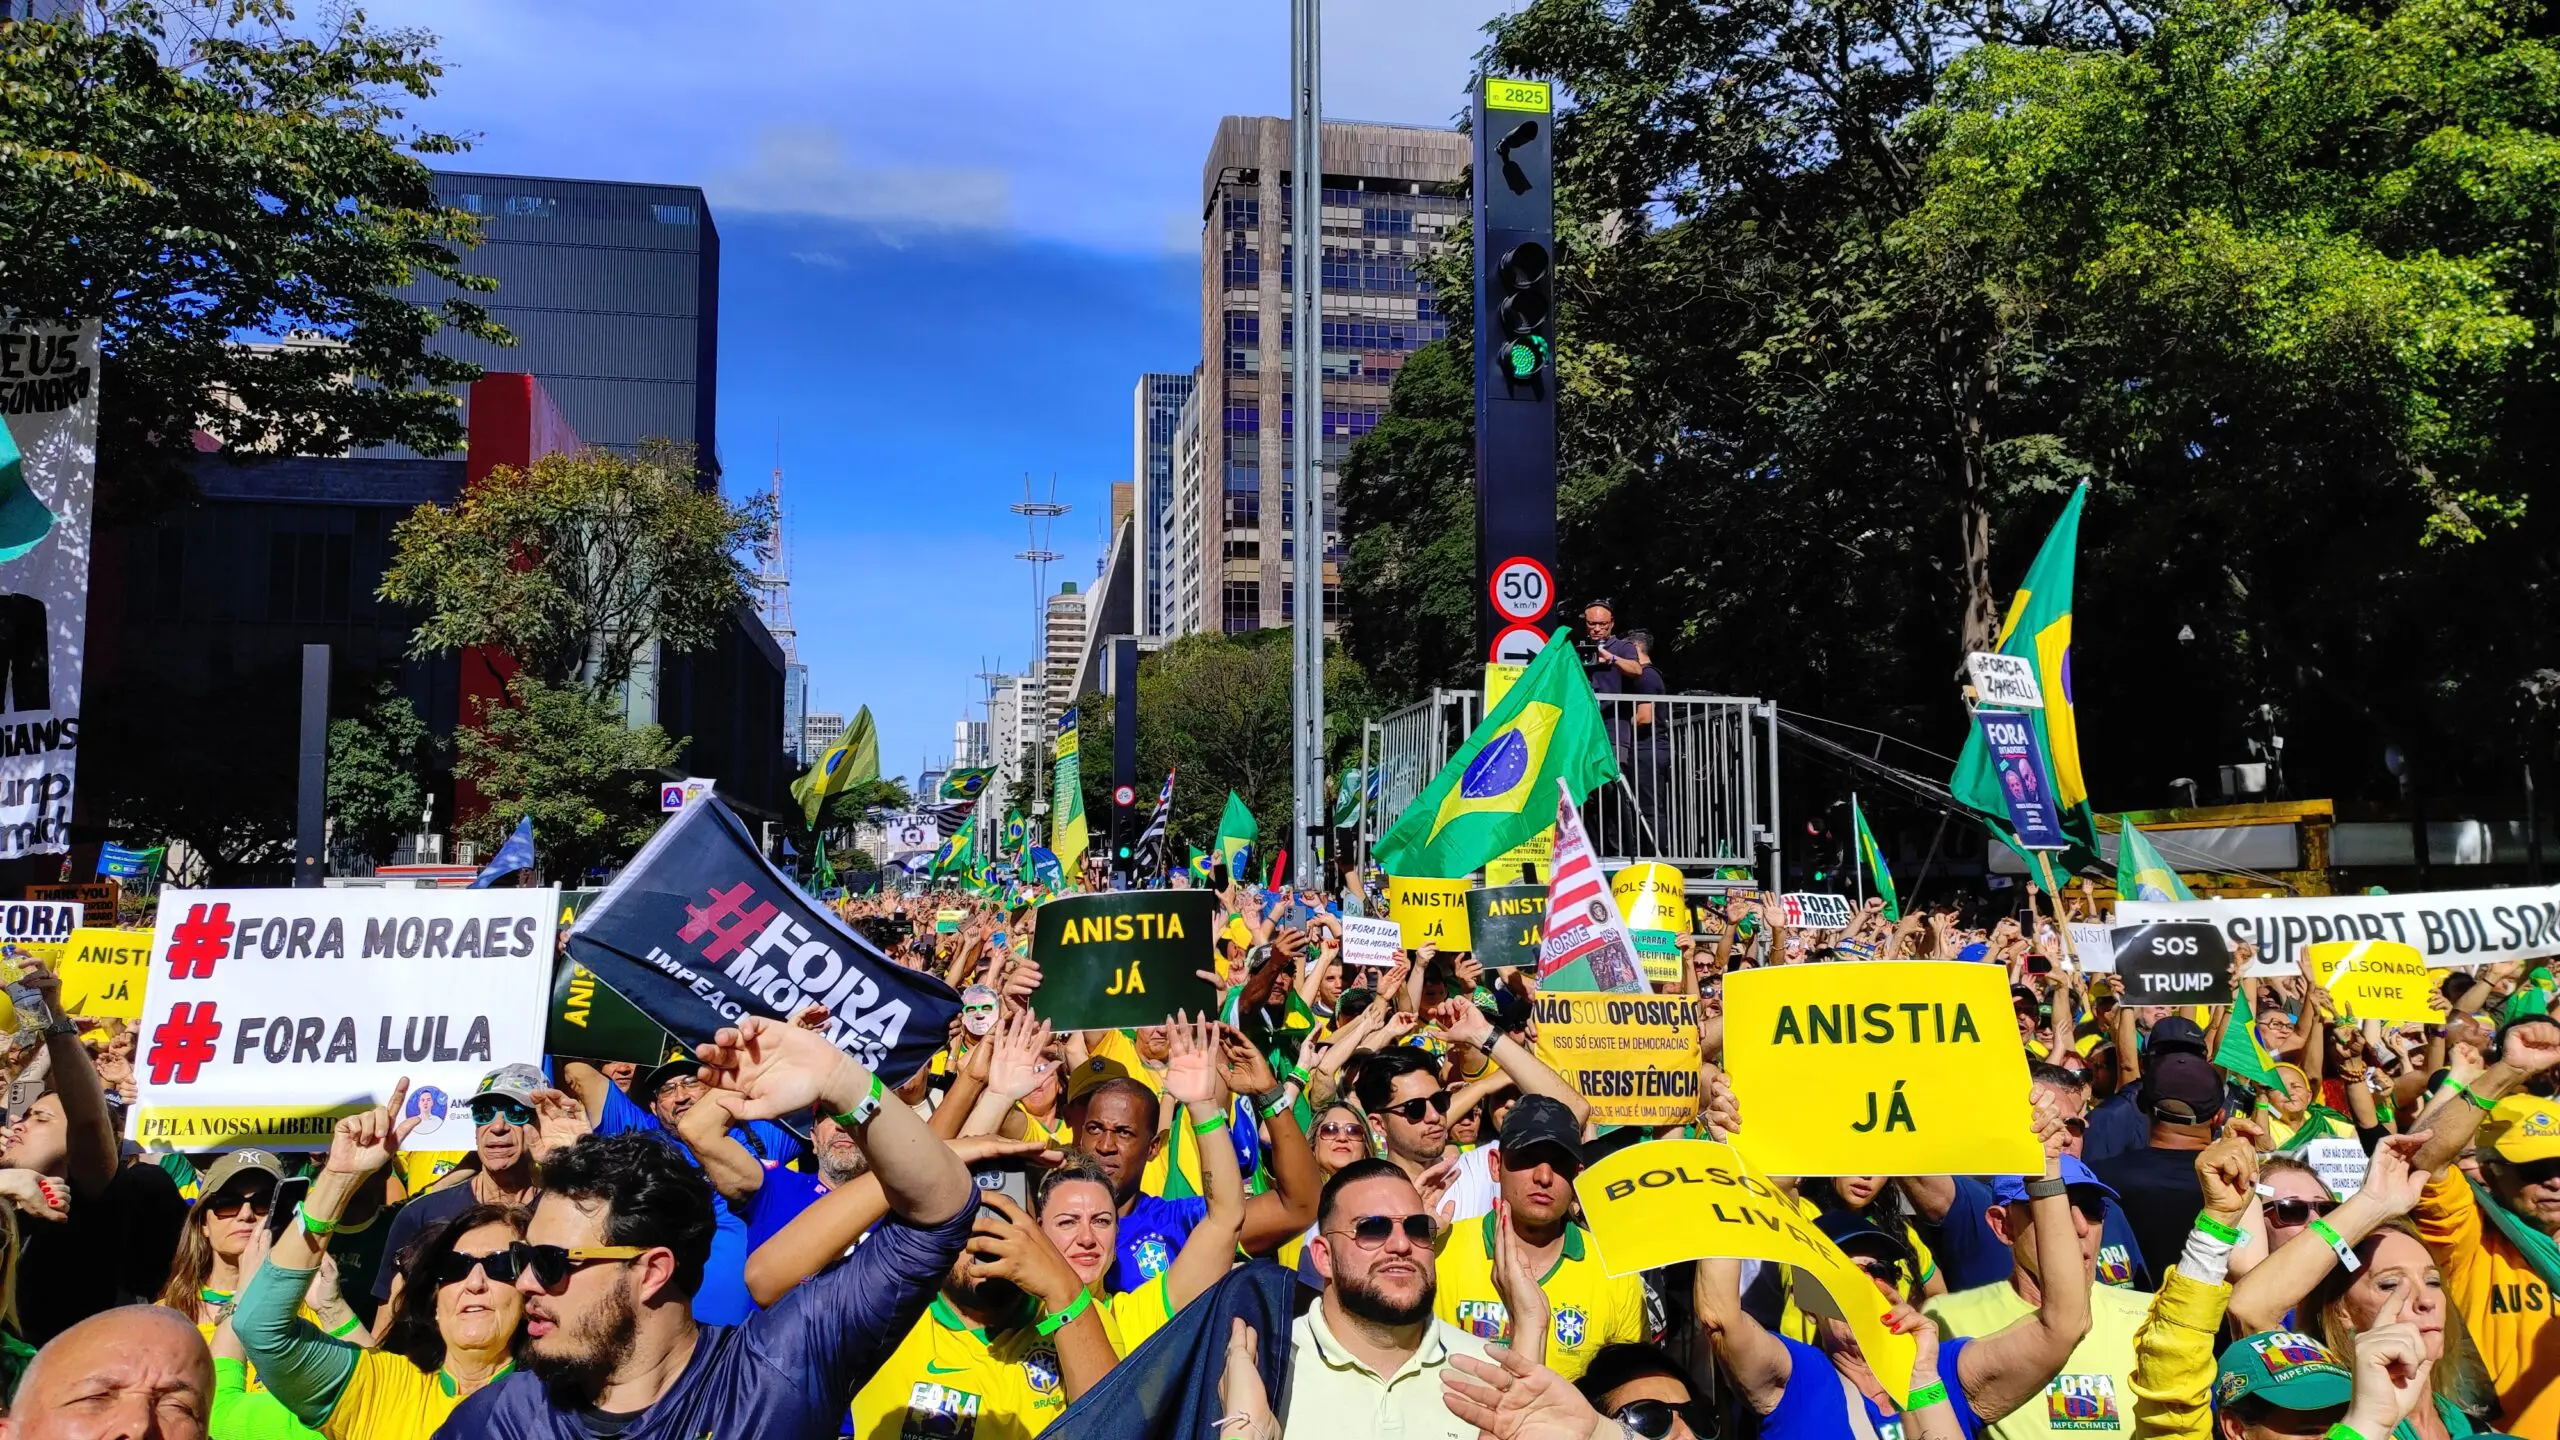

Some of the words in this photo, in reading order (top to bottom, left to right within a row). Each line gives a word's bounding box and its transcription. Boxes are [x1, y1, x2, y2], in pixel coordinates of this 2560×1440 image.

[1505, 88, 1543, 105] 2825
[1503, 572, 1542, 600] 50
[1513, 601, 1538, 609] km/h
[1986, 723, 2029, 746] FORA
[909, 815, 936, 827] LIXO
[1401, 891, 1465, 908] ANISTIA
[1061, 913, 1185, 946] ANISTIA
[1423, 920, 1444, 937] JÁ
[1804, 912, 1850, 927] MORAES
[362, 916, 537, 959] MORAES
[1377, 926, 1398, 938] LULA
[1519, 925, 1543, 946] JÁ
[1545, 923, 1591, 961] NORTE
[1600, 927, 1620, 944] USA
[2152, 937, 2199, 956] SOS
[2322, 959, 2427, 977] BOLSONARO
[1105, 961, 1146, 996] JÁ
[2140, 973, 2214, 992] TRUMP
[101, 980, 129, 1001] JÁ
[2358, 986, 2404, 999] LIVRE
[1533, 994, 1572, 1024] NÃO
[1571, 1000, 1609, 1025] SOU
[1771, 1003, 1981, 1045] ANISTIA
[376, 1015, 492, 1063] LULA
[1553, 1036, 1573, 1049] ISSO
[1575, 1034, 1587, 1050] SÓ
[1589, 1036, 1616, 1050] EXISTE
[1618, 1037, 1631, 1050] EM
[1632, 1037, 1690, 1051] DEMOCRACIAS
[1578, 1065, 1699, 1098] RESISTÊNCIA
[1615, 1106, 1633, 1118] HOJE
[1634, 1104, 1640, 1118] É
[1641, 1106, 1657, 1118] UMA
[1659, 1106, 1692, 1118] DITADURA
[1851, 1080, 1917, 1133] JÁ
[143, 1118, 195, 1137] PELA
[200, 1117, 263, 1136] NOSSA
[1711, 1203, 1841, 1270] LIVRE
[2490, 1283, 2544, 1314] AUS
[2050, 1421, 2120, 1430] IMPEACHMENT
